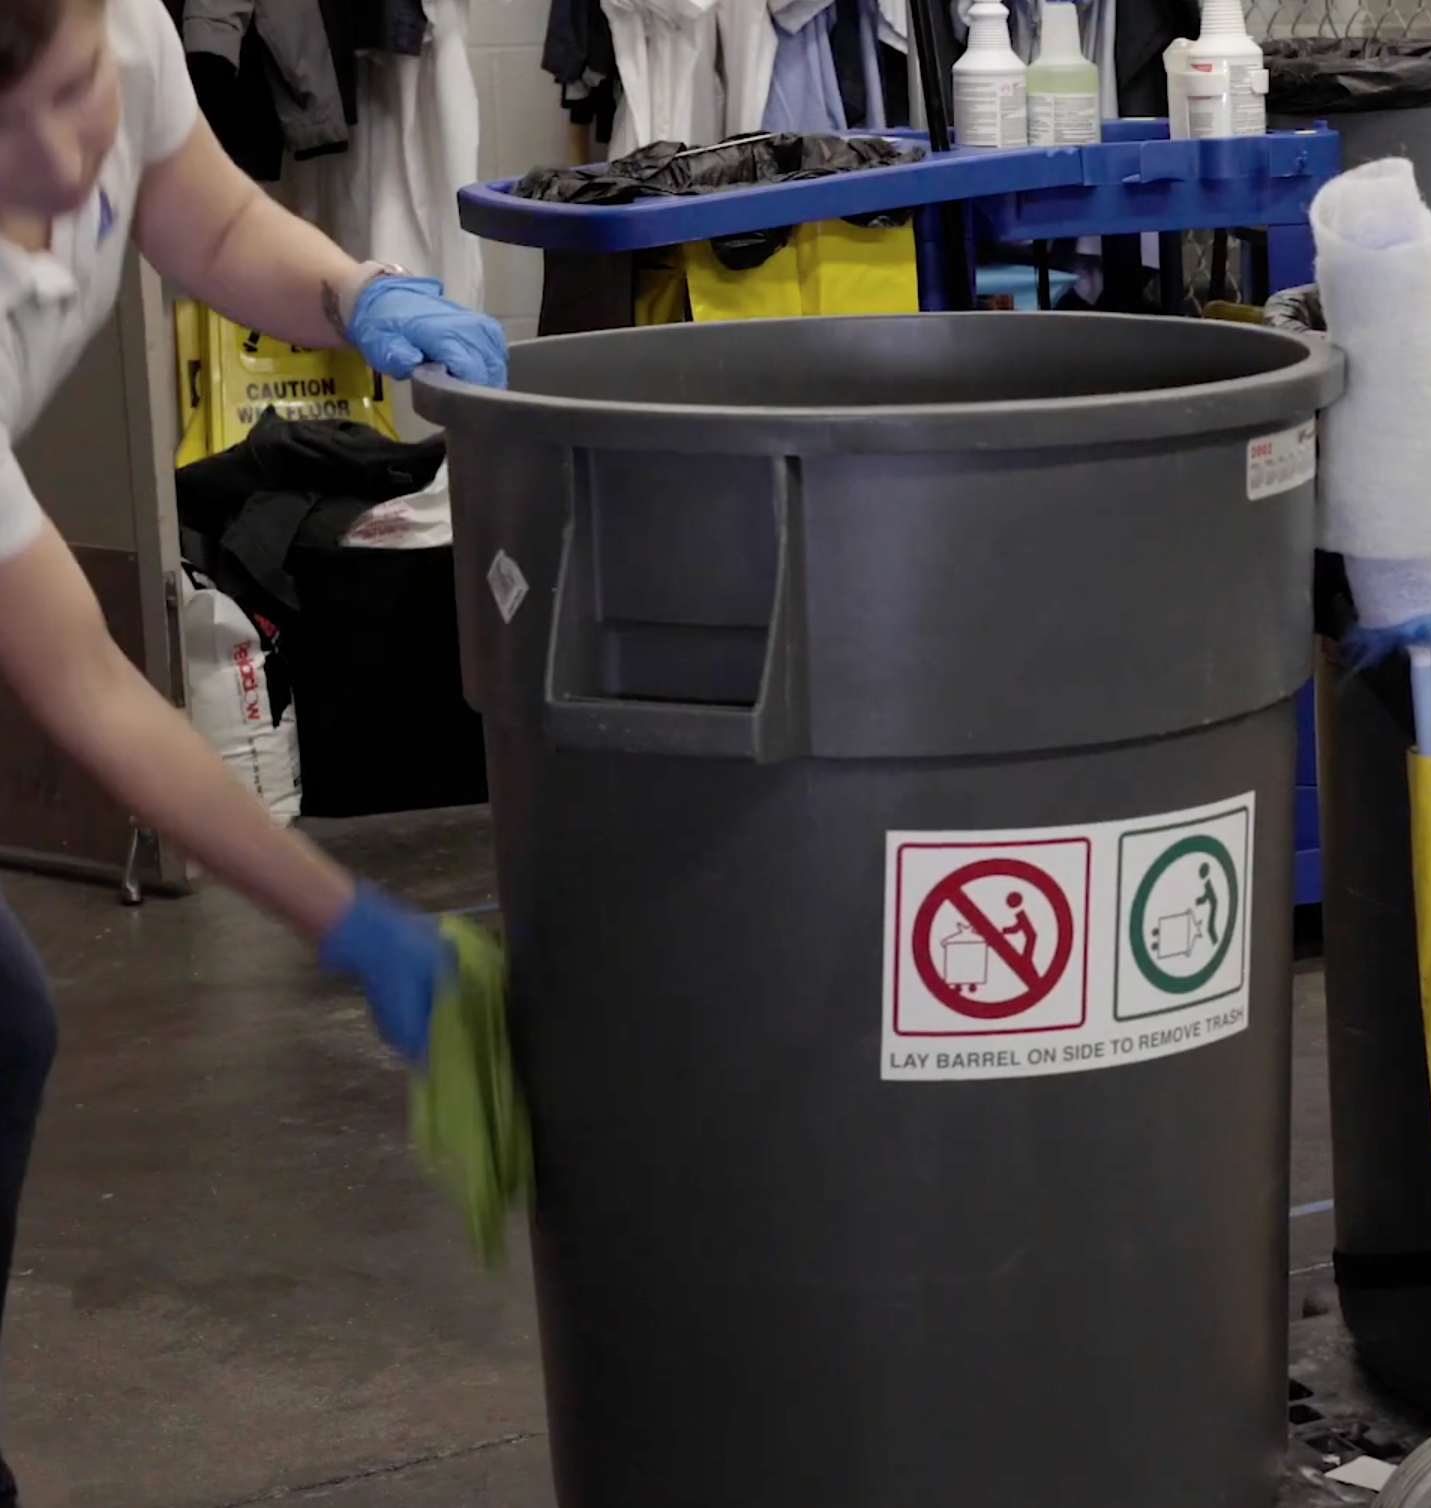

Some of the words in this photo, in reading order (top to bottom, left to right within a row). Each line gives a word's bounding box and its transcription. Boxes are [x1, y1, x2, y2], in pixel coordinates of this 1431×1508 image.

[246, 378, 335, 400] CAUTION
[286, 399, 350, 420] FLOOR
[889, 1052, 930, 1069] LAY
[936, 1050, 1021, 1069] BARREL
[1027, 1047, 1057, 1065] ON
[1062, 1041, 1106, 1062] SIDE
[1110, 1037, 1134, 1055] TO
[1138, 1020, 1201, 1050] REMOVE
[1205, 1005, 1245, 1032] TRASH
